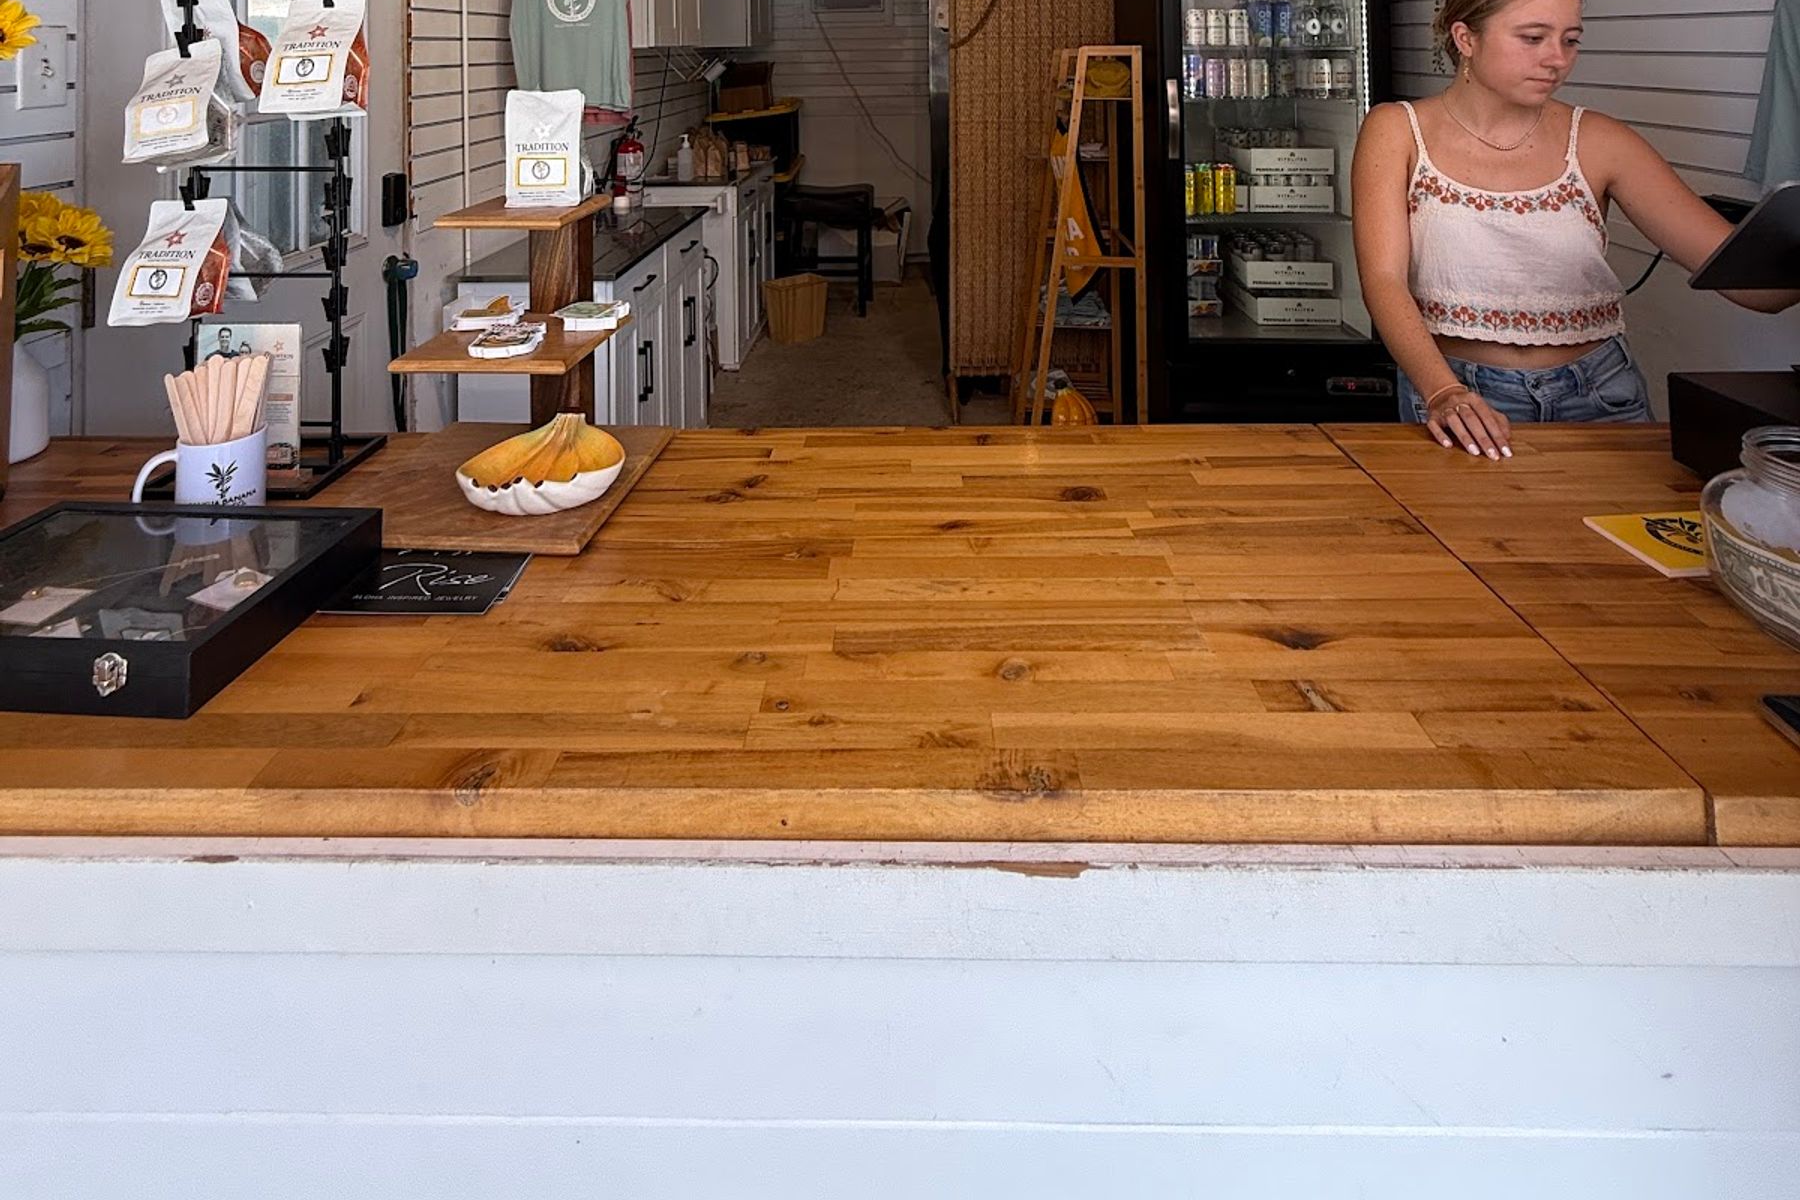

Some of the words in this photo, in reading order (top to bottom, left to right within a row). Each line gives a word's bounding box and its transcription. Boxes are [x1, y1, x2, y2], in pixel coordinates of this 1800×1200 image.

[283, 40, 342, 52] TRADITION
[141, 86, 202, 103] TRADITION
[515, 142, 569, 152] TRADITION
[138, 250, 197, 260] TRADITION
[378, 563, 496, 596] Rise
